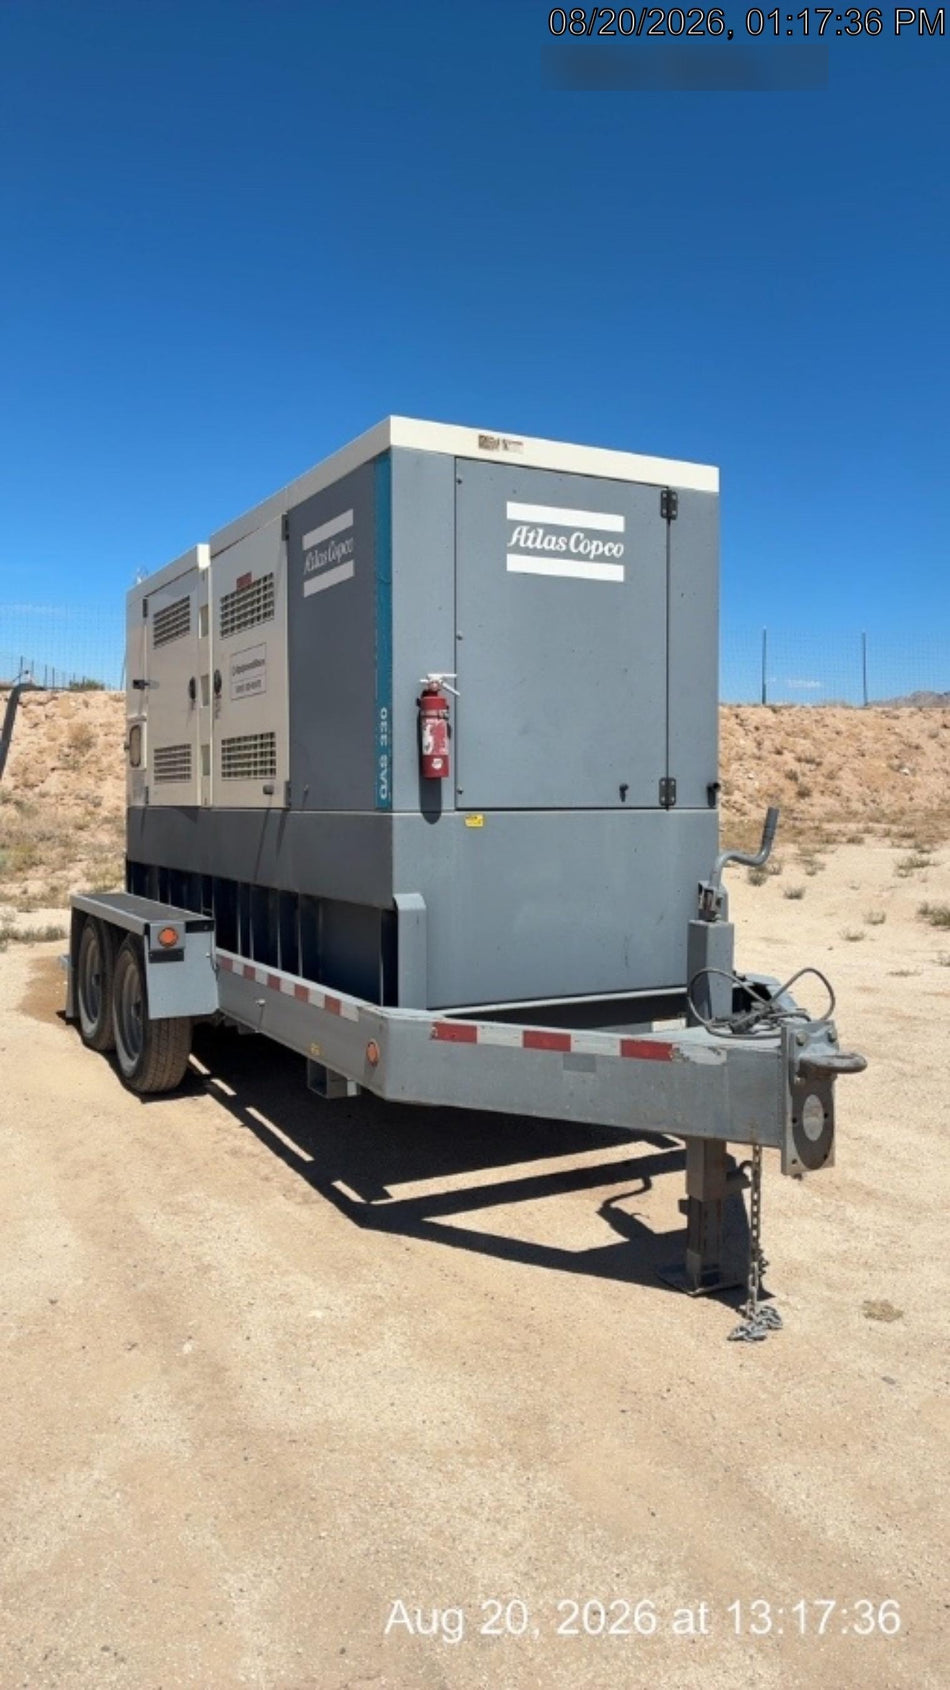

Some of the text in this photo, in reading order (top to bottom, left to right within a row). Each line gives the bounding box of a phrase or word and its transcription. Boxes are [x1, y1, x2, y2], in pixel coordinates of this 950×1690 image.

[507, 525, 625, 560] Atlas Copco
[380, 707, 388, 800] QAS 330
